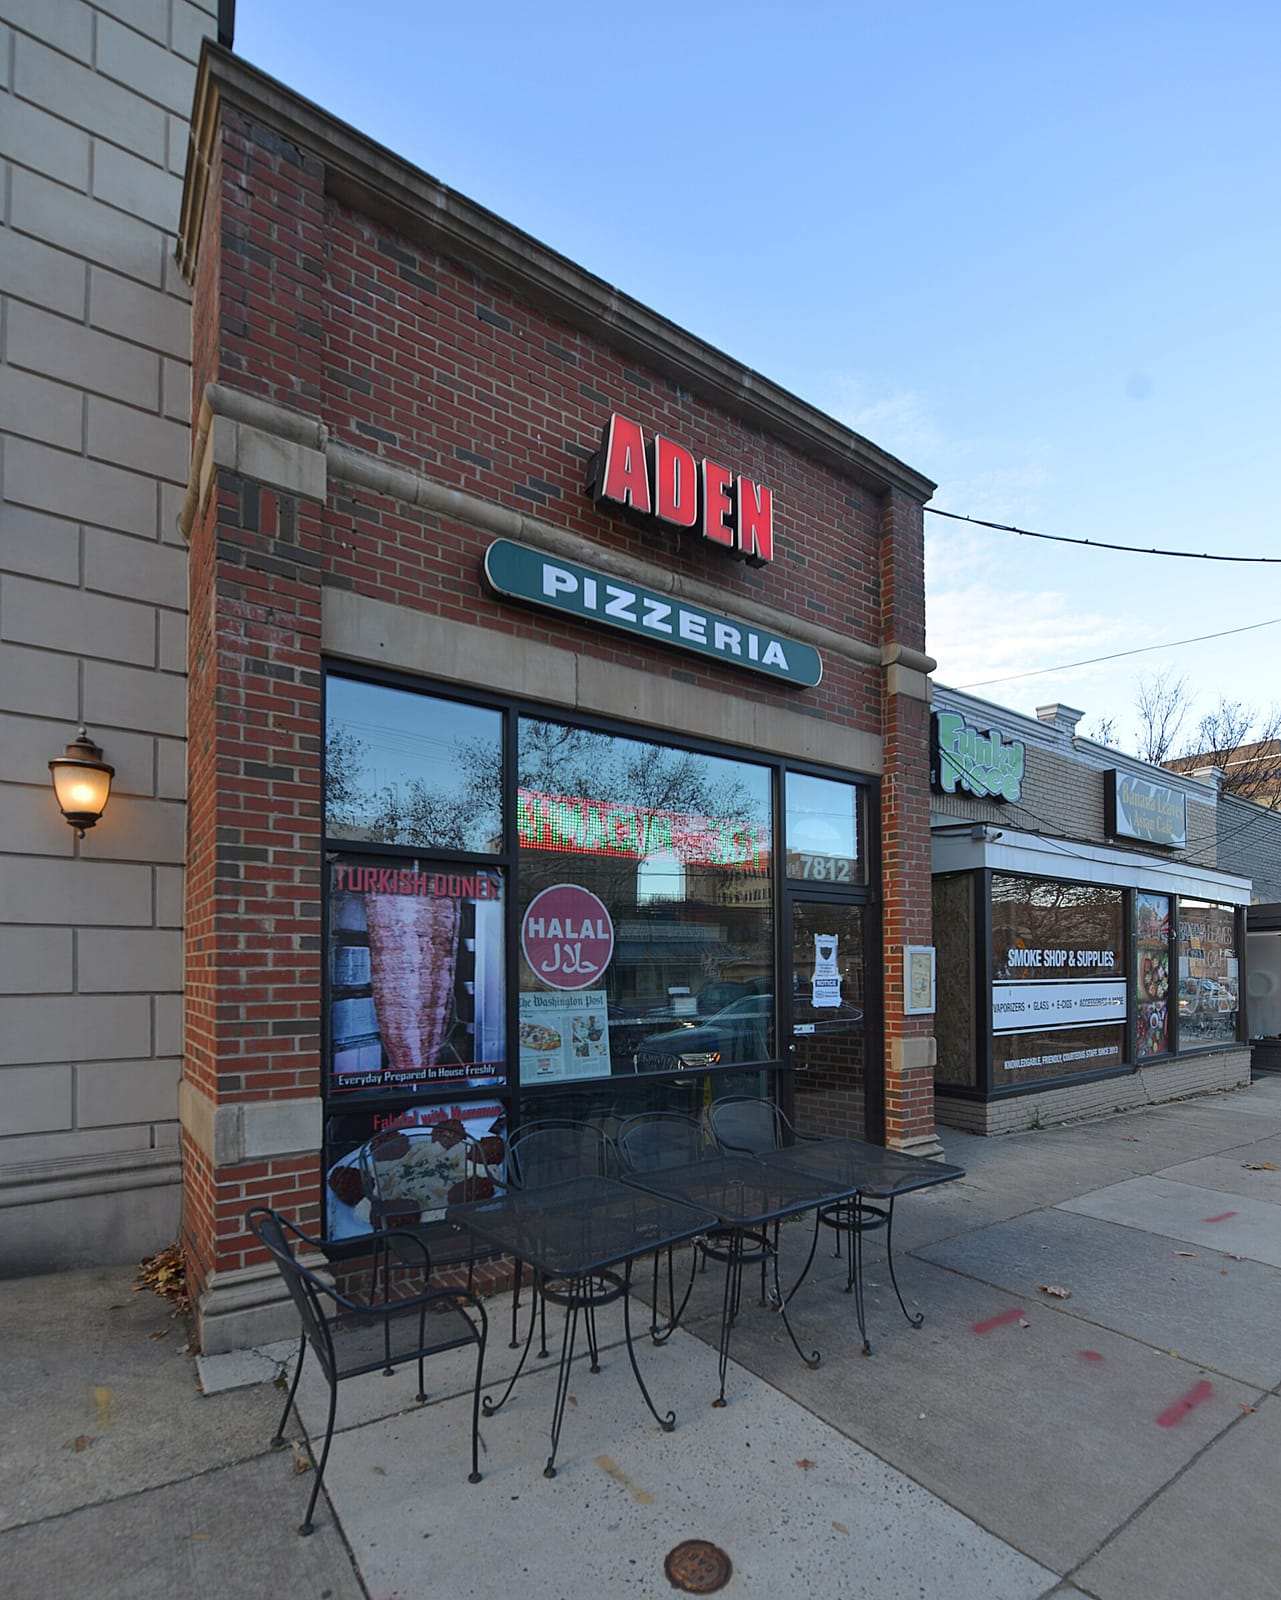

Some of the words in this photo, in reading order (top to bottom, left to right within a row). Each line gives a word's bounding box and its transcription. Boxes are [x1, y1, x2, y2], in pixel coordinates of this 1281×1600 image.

[601, 411, 774, 562] ADEN
[541, 563, 790, 671] PIZZERIA
[939, 712, 1025, 779] Funky
[1122, 782, 1155, 811] Banana
[334, 865, 427, 896] TURKISH
[800, 855, 850, 881] 7812
[528, 917, 610, 939] HALAL
[541, 942, 599, 974] حلال
[1007, 949, 1042, 967] SMOKE
[1043, 949, 1067, 967] SHOP
[1068, 950, 1076, 967] &
[1077, 950, 1115, 967] SUPPLIES
[534, 994, 584, 1009] Washington
[586, 995, 604, 1007] Post
[993, 1002, 1026, 1013] VAPORIZERS
[1033, 1001, 1049, 1011] GLASS
[338, 1074, 382, 1086] Everyday
[384, 1069, 426, 1083] Prepared
[428, 1068, 437, 1077] In
[438, 1067, 464, 1077] House
[465, 1063, 496, 1075] Freshly
[420, 1106, 448, 1125] with
